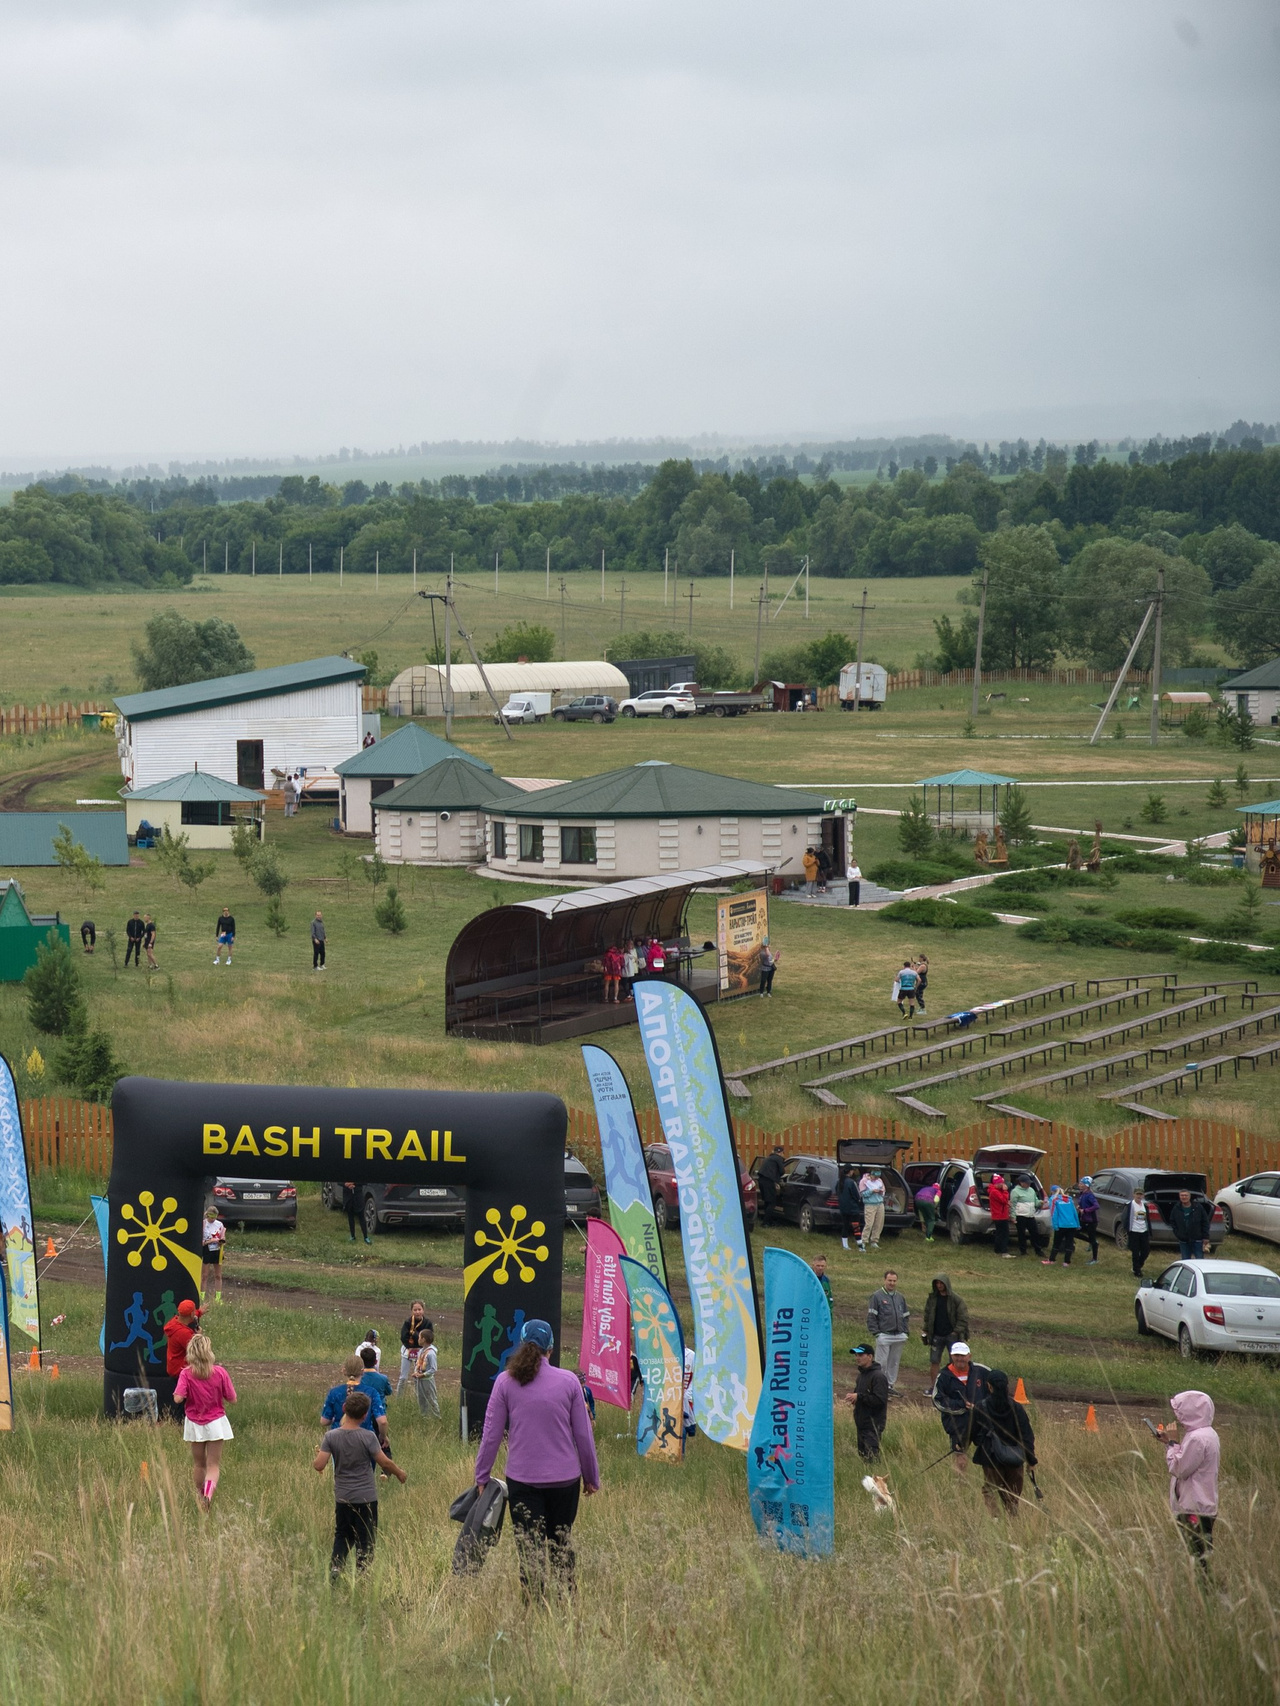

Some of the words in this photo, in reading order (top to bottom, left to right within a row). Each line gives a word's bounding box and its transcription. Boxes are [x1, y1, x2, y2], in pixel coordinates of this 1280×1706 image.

[202, 1123, 321, 1158] BASH
[334, 1127, 467, 1163] TRAIL
[772, 1307, 794, 1343] Ufa
[770, 1350, 791, 1391] Run
[798, 1307, 811, 1392] СООБЩЕСТВО
[769, 1397, 795, 1449] Lady
[795, 1400, 807, 1485] СПОРТИВНОЕ
